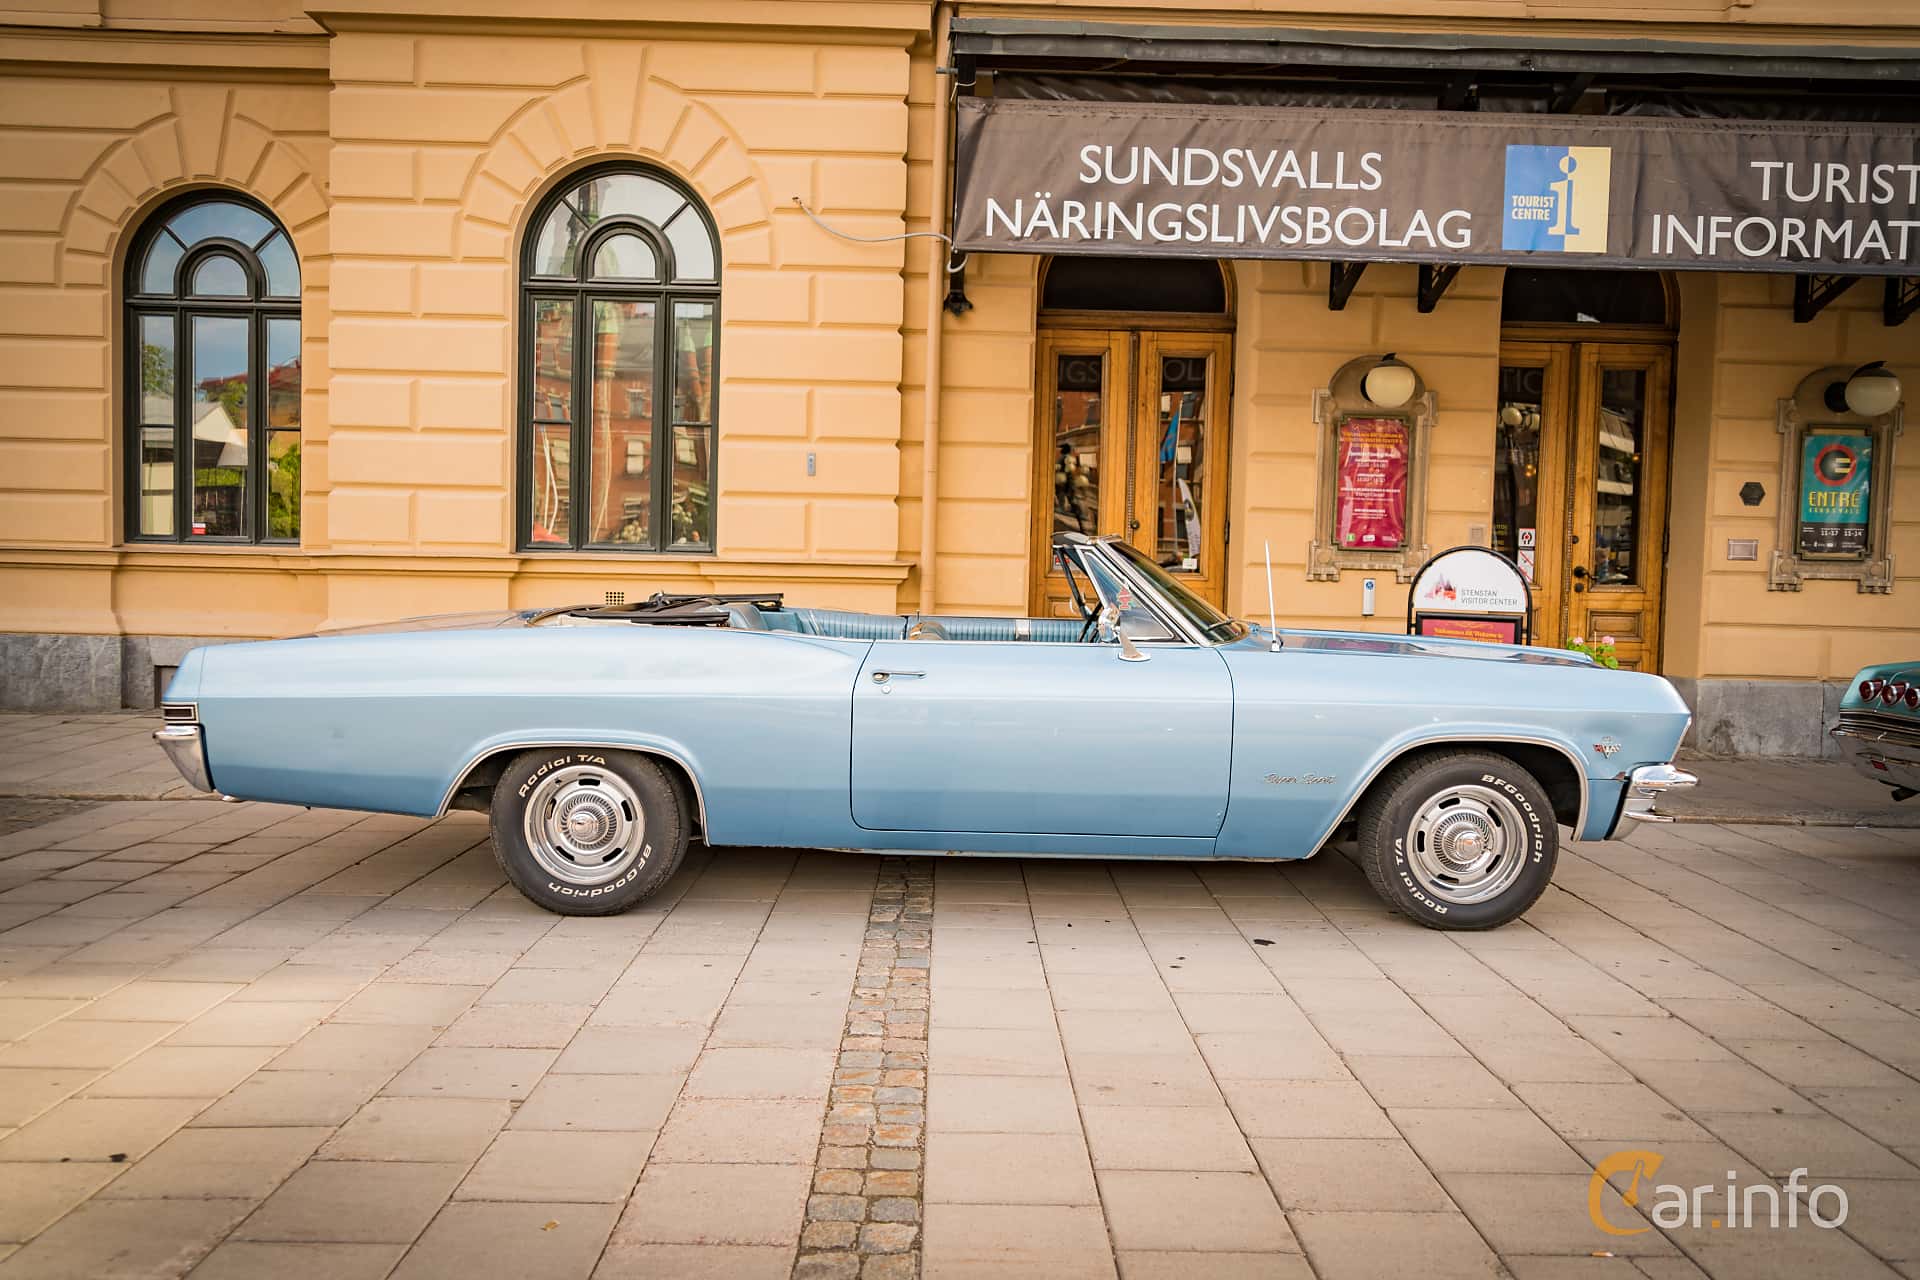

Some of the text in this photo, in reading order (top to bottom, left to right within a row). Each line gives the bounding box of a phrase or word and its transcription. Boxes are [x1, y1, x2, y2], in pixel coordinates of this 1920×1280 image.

[1079, 144, 1383, 191] SUNDSVALLS
[985, 191, 1472, 249] NÄRINGSLIVSBOLAG
[1511, 195, 1555, 208] TOURIST
[1511, 208, 1551, 221] CENTRE
[1461, 589, 1498, 597] STENSTAN
[1461, 597, 1518, 606] VISITOR CENTER
[518, 754, 607, 798] Radial T/A
[1480, 774, 1544, 863] BFGoodrich
[548, 843, 652, 898] BFGoodrich
[1394, 838, 1449, 915] Radial T/A
